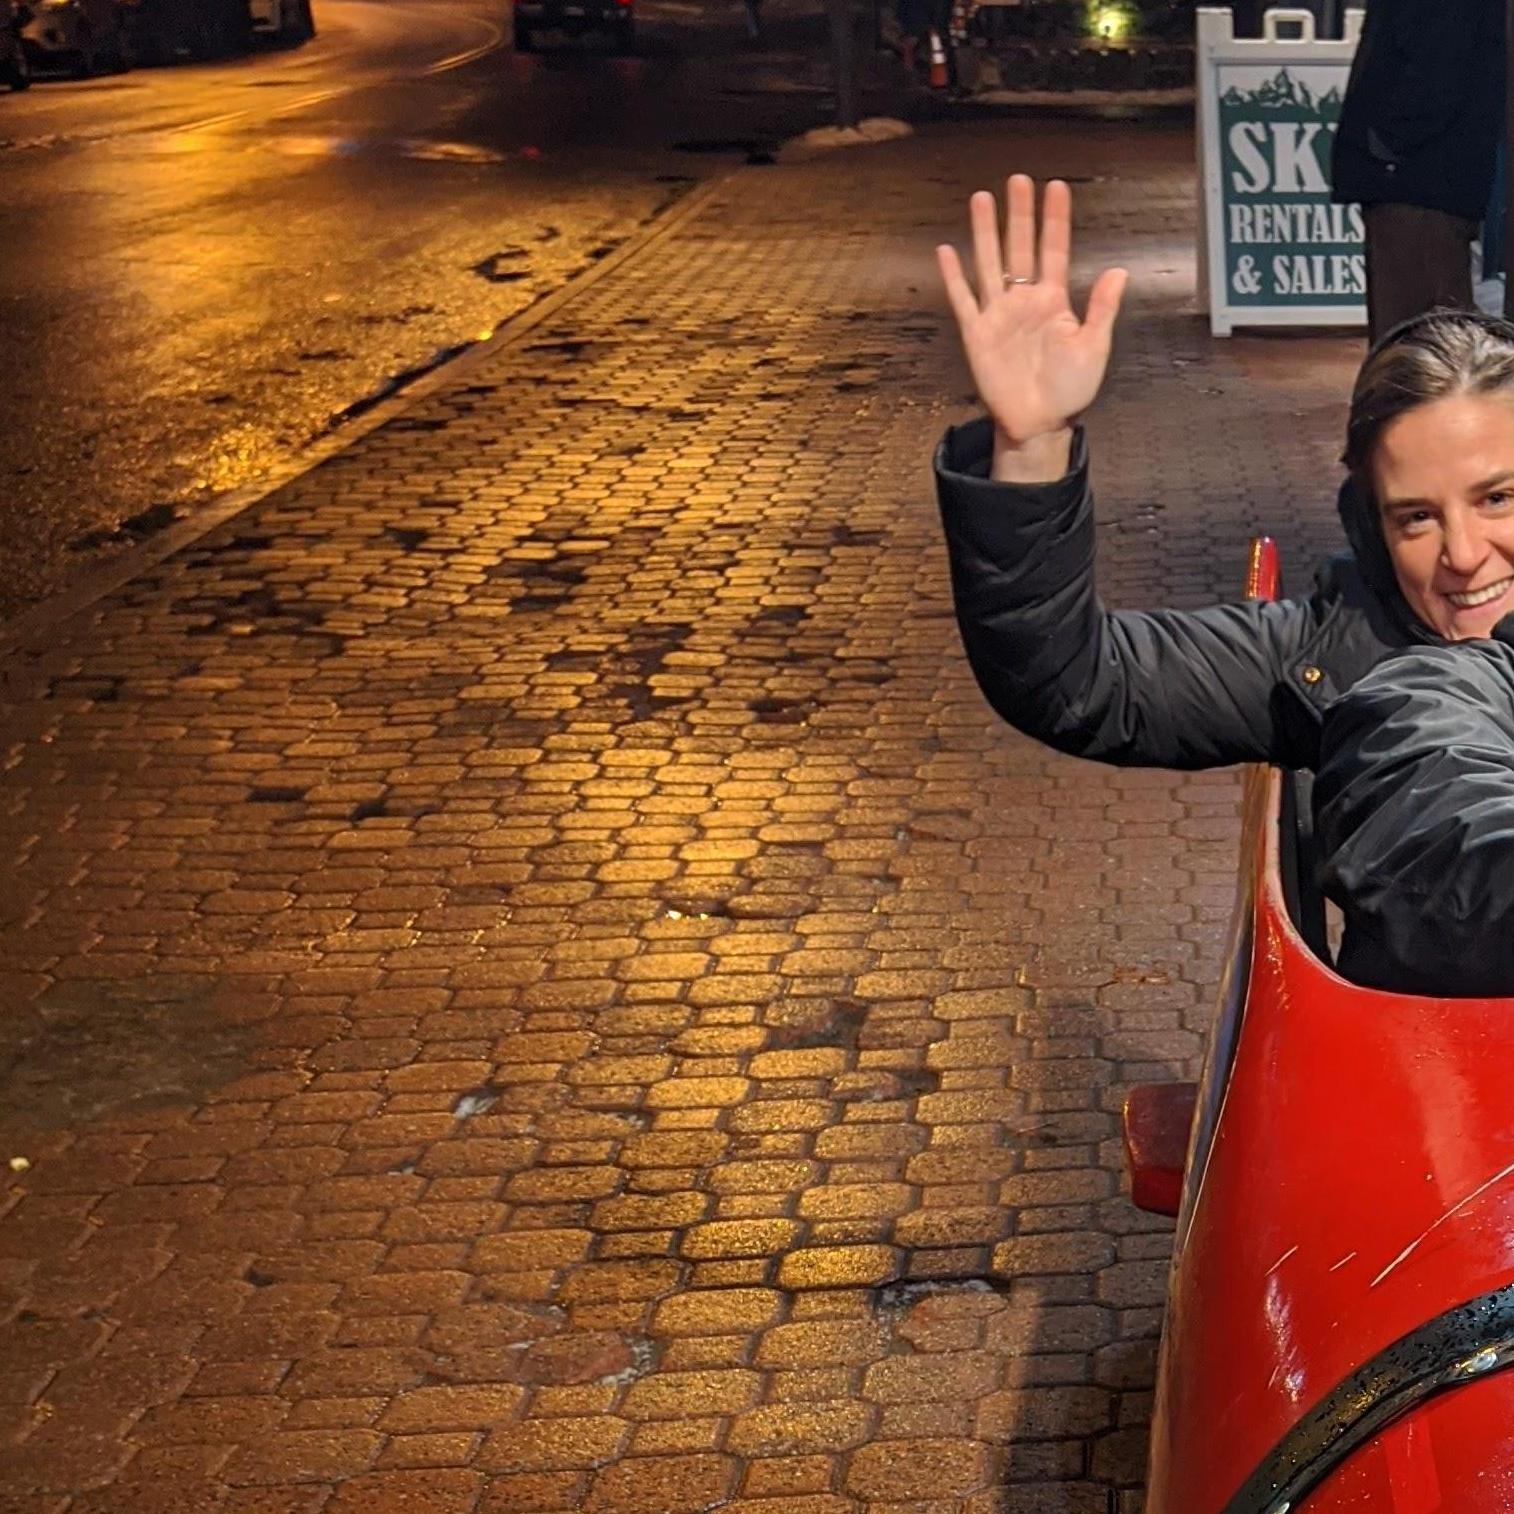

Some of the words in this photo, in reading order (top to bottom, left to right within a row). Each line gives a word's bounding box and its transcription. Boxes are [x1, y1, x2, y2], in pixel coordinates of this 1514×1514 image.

[1228, 121, 1339, 194] SK
[1229, 202, 1366, 244] RENTALS
[1232, 254, 1262, 294] &
[1272, 254, 1366, 295] SALES
